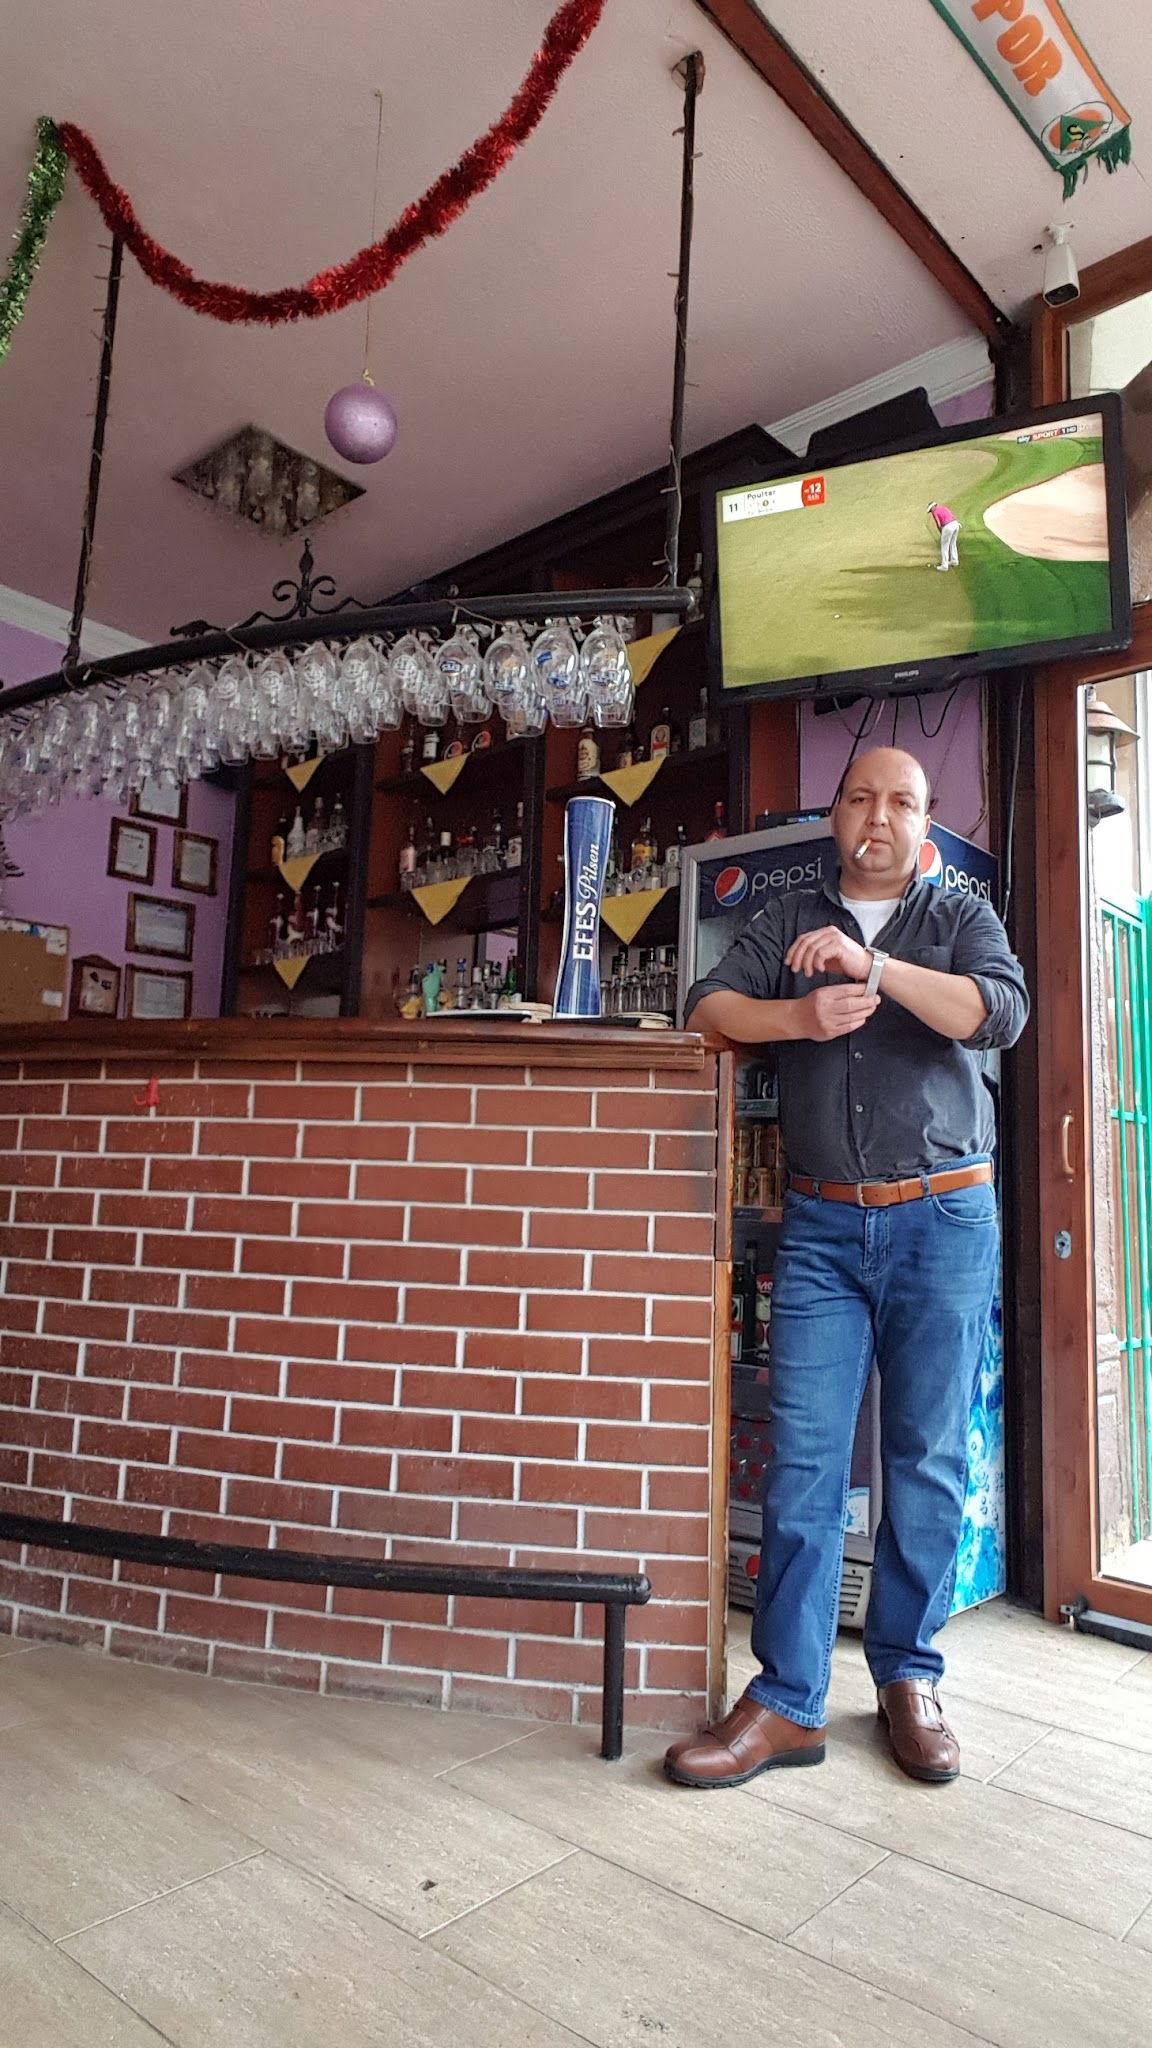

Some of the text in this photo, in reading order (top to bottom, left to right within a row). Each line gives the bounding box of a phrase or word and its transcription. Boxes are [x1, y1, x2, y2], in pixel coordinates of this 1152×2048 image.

[1032, 430, 1058, 440] SPORT
[729, 503, 738, 513] 11
[751, 856, 822, 897] pepsi
[572, 843, 600, 961] EFES Pilsen
